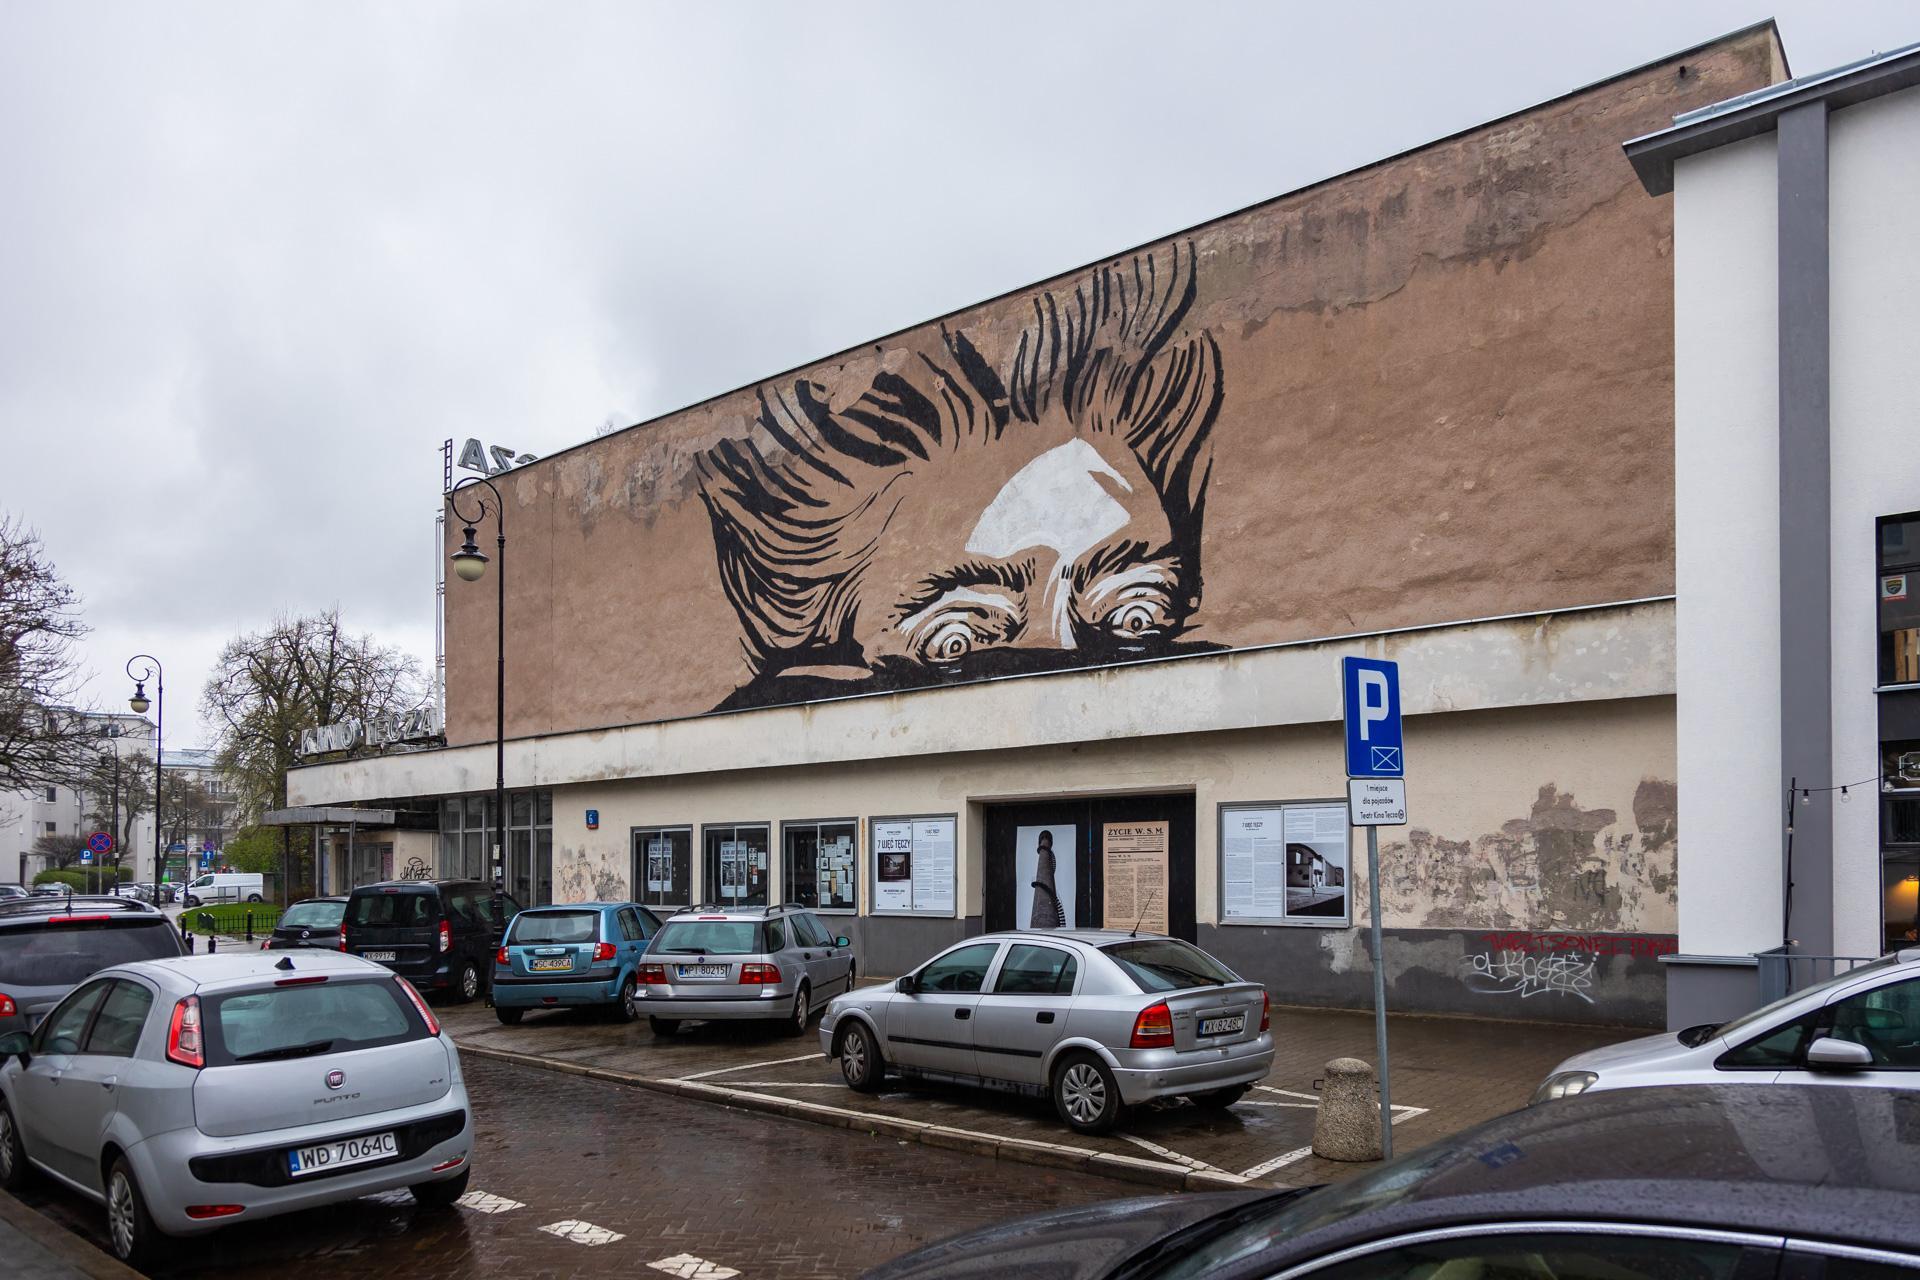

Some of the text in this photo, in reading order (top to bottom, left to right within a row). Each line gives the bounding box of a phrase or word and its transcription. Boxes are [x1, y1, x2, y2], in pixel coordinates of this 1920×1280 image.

[1358, 669, 1389, 740] P
[301, 719, 359, 755] KINO
[1370, 784, 1388, 793] miejsce
[588, 814, 593, 824] 6
[1360, 811, 1373, 819] Teatr
[1374, 811, 1384, 819] Kino
[877, 839, 881, 849] 7
[83, 851, 91, 859] P
[364, 952, 374, 960] WX
[701, 965, 725, 975] 80215
[1204, 1017, 1242, 1033] WX 8248C
[313, 1092, 361, 1104] PUNTO
[302, 1134, 394, 1168] WD 7064C
